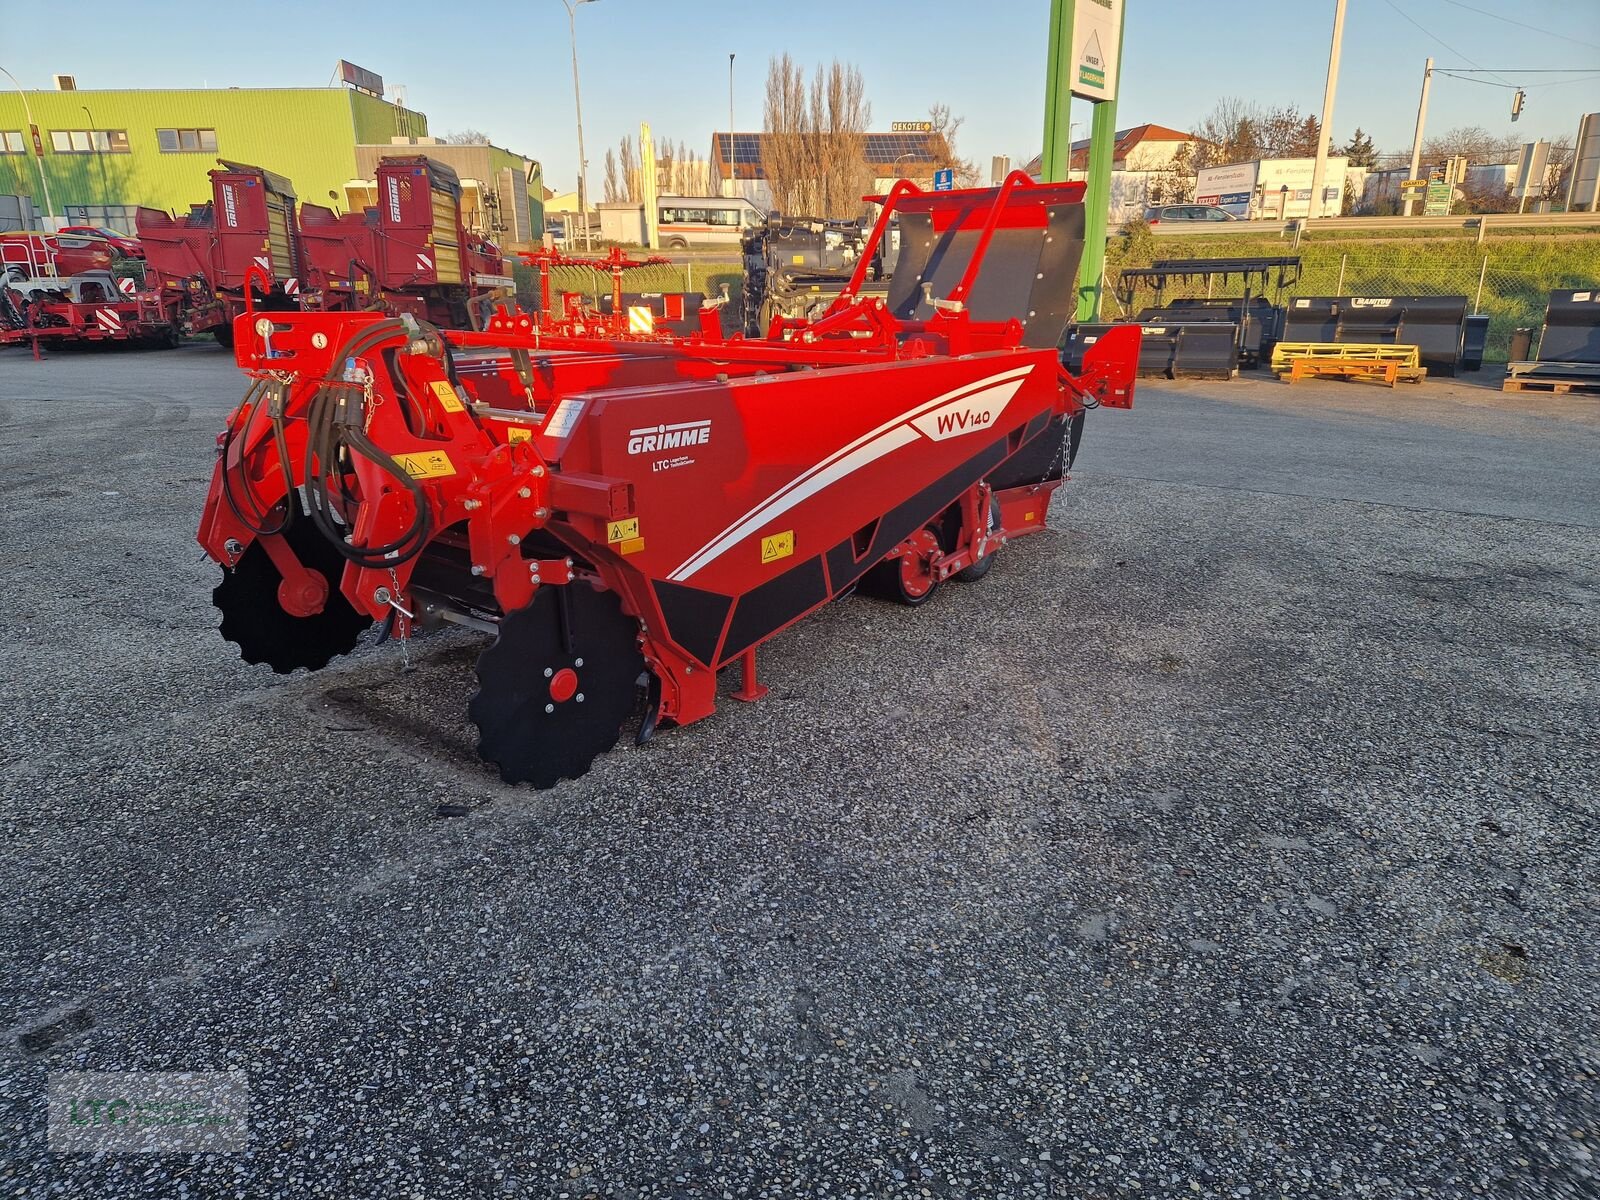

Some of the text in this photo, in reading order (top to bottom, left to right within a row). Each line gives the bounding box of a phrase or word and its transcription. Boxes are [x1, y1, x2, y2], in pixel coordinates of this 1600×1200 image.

[892, 122, 924, 131] OEKOTEL
[222, 184, 237, 228] GRIMME
[387, 176, 401, 223] GRIMME
[1351, 298, 1392, 308] MANITOU
[627, 420, 711, 455] GRIMME
[652, 459, 670, 472] LTC
